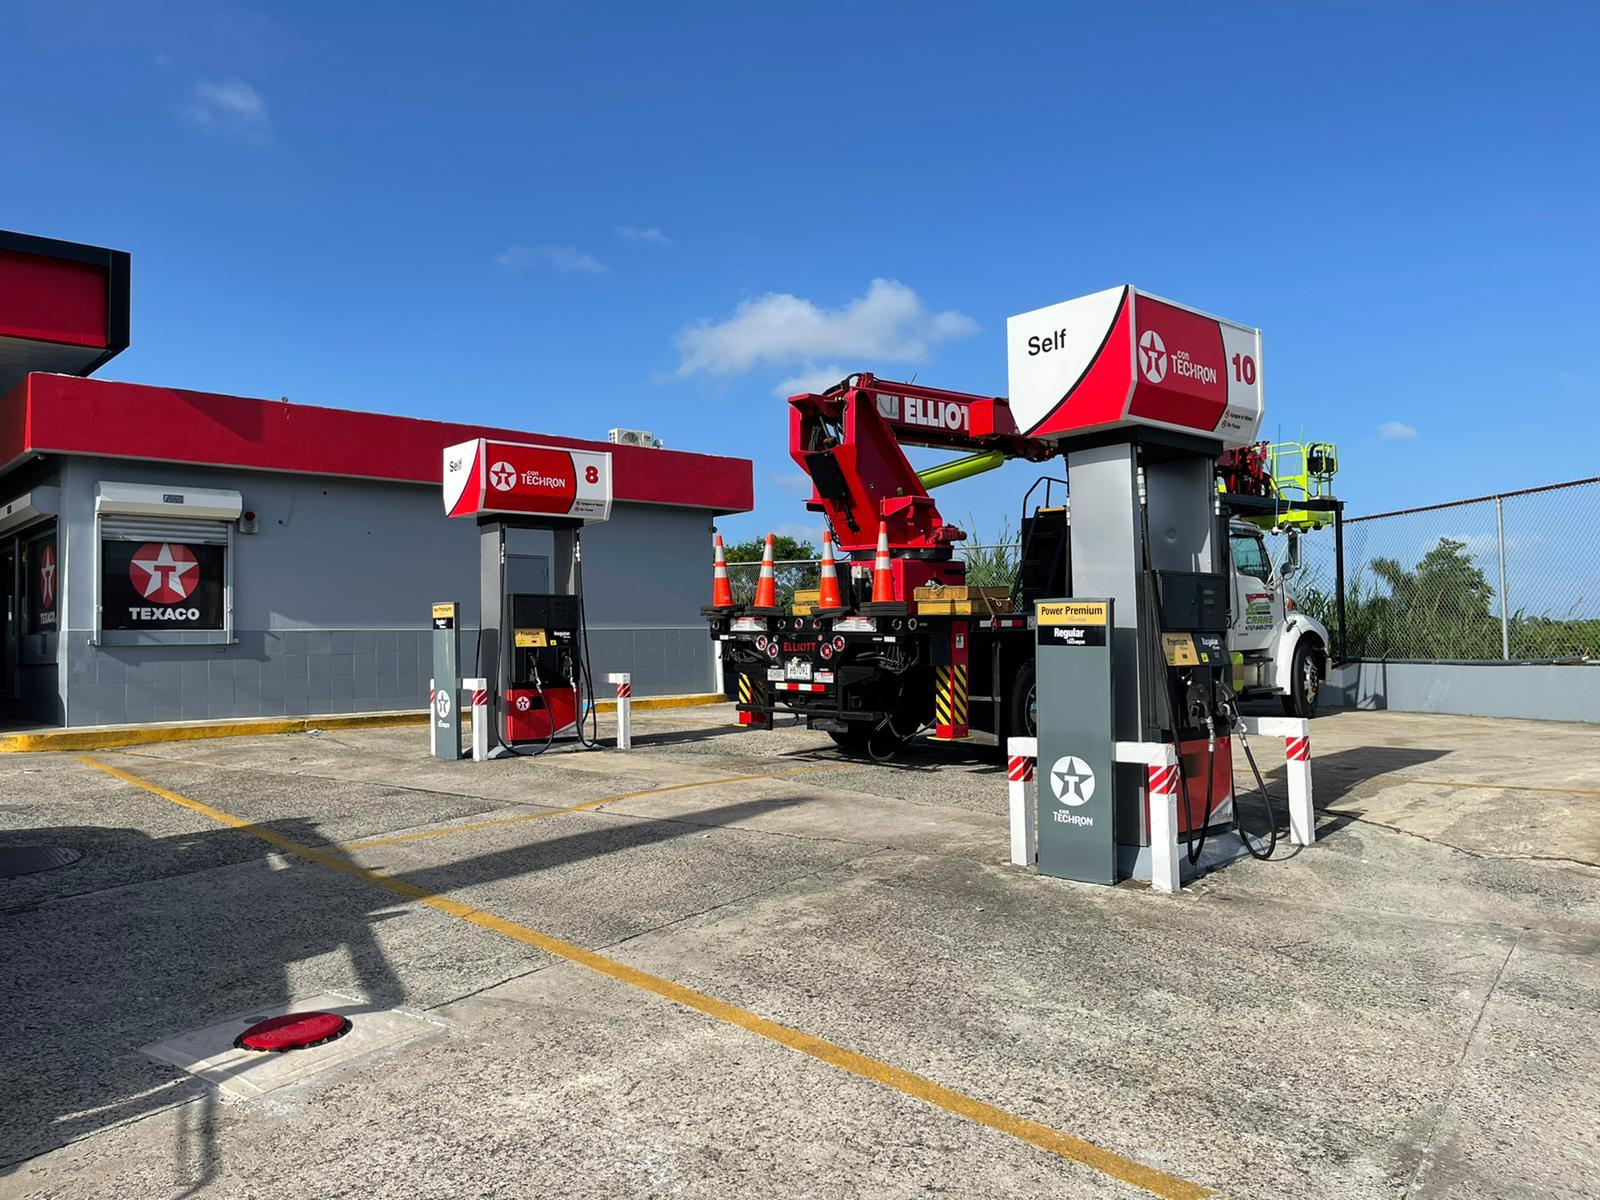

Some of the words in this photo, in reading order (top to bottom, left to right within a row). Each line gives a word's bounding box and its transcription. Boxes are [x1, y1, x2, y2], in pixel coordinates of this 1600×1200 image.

[1028, 328, 1066, 356] Self
[1177, 350, 1190, 360] con
[1171, 354, 1217, 384] TECHRON
[1232, 353, 1256, 385] 10
[450, 459, 462, 472] Self
[521, 473, 566, 489] TECHRON
[585, 465, 599, 484] 8
[128, 607, 200, 621] TEXACO
[1041, 606, 1063, 615] Power
[1065, 605, 1103, 615] Premium
[1246, 616, 1273, 624] CRANE
[1053, 628, 1085, 639] Regular
[783, 642, 816, 652] ELLIOTT
[1053, 811, 1093, 827] TECHRON
